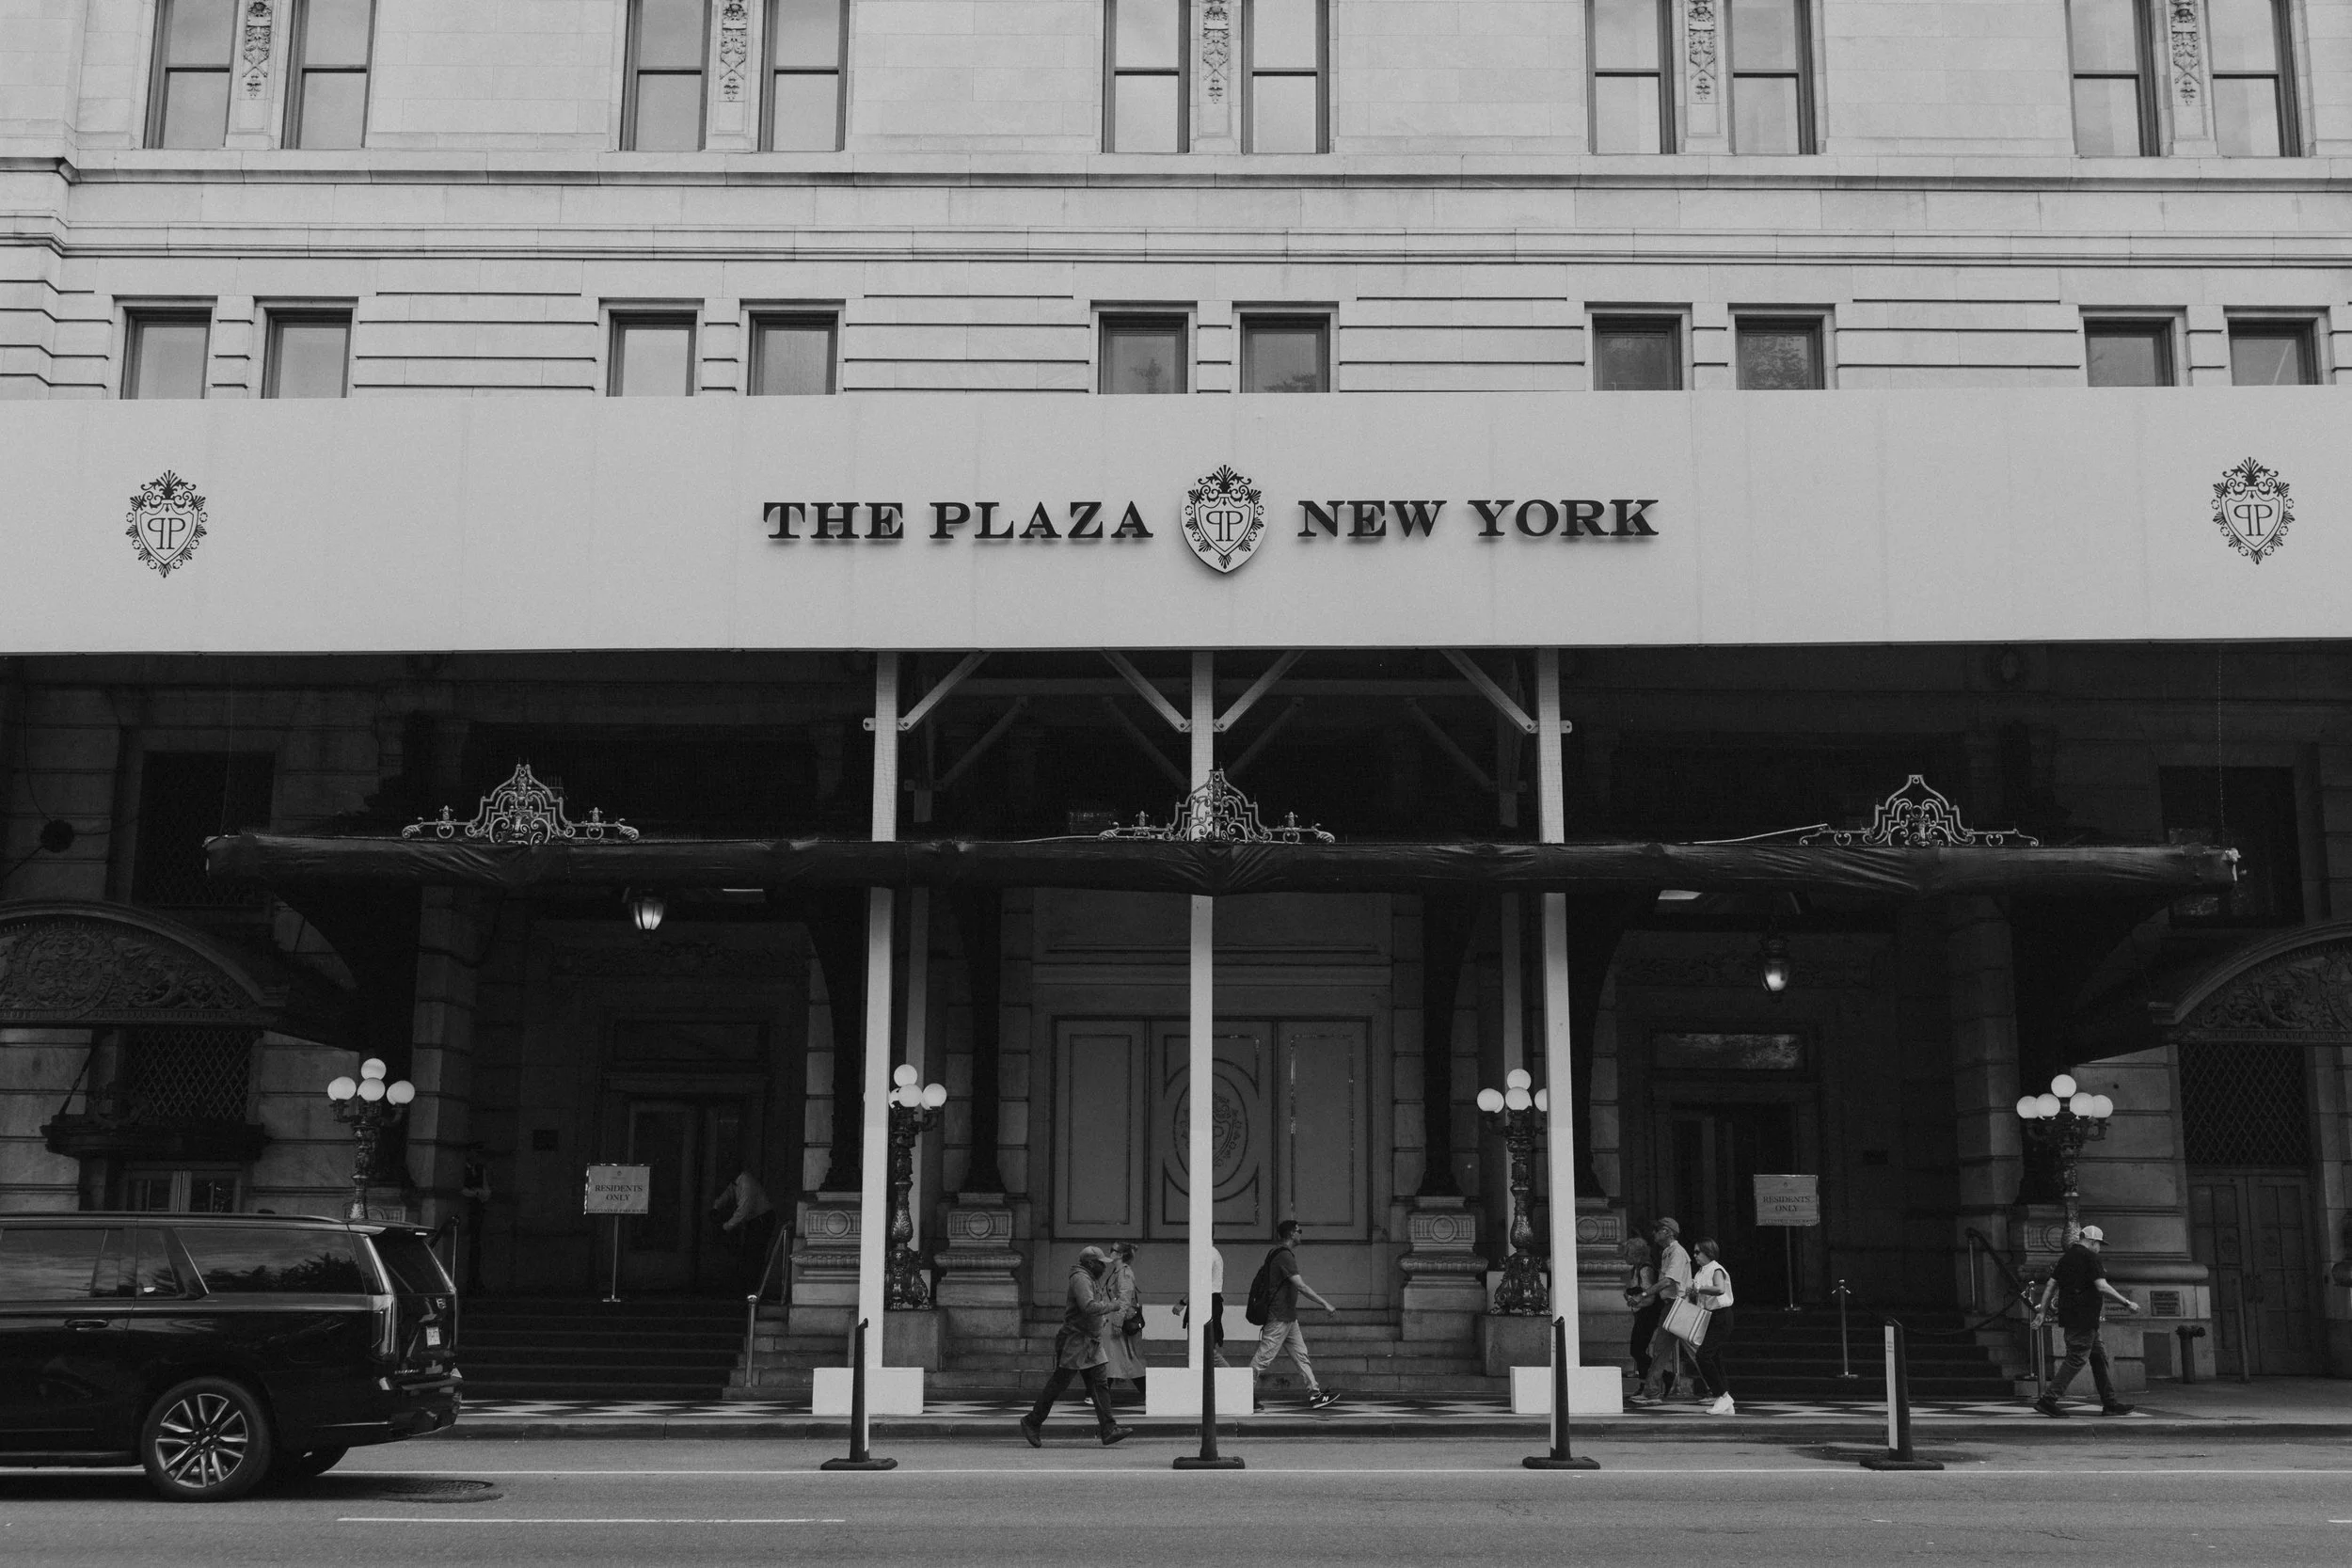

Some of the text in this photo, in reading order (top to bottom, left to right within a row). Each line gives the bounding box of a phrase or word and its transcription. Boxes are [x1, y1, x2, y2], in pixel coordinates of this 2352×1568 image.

[763, 501, 1154, 540] THE PLAZA
[1297, 499, 1660, 537] NEW YORK
